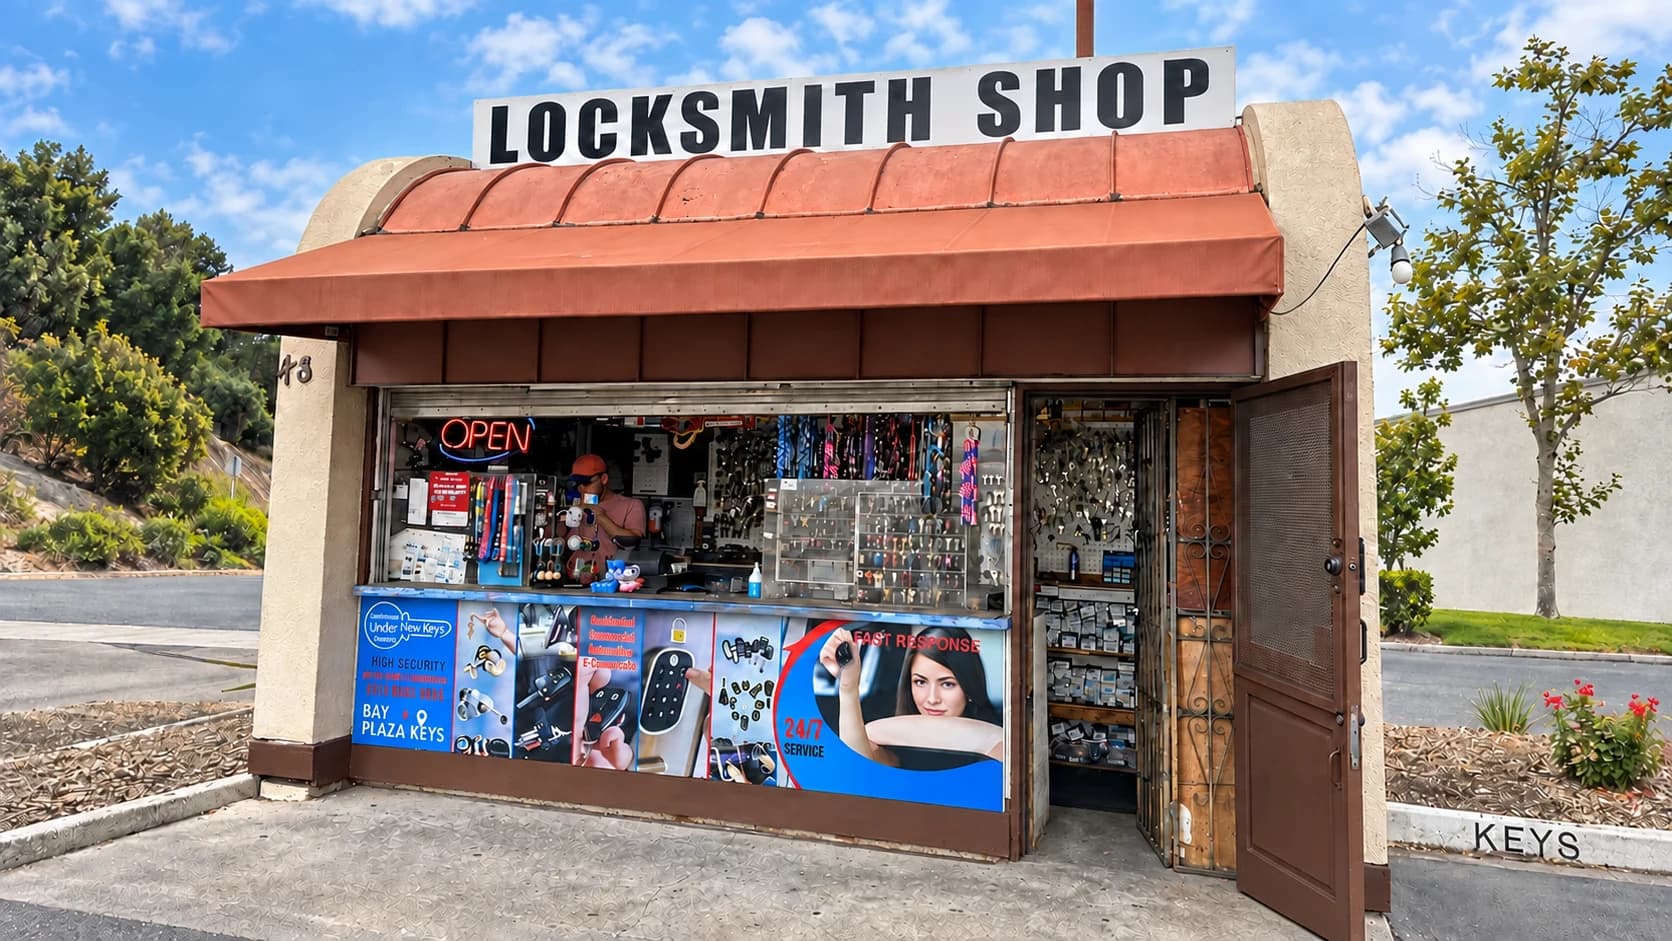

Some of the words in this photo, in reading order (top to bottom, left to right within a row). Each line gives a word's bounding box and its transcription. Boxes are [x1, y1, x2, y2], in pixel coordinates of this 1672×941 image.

[489, 77, 931, 165] LOCKSMITH
[977, 58, 1209, 138] SHOP
[276, 354, 312, 386] 48
[441, 418, 530, 453] OPEN
[369, 621, 398, 633] Under
[400, 621, 421, 633] New
[423, 622, 446, 638] Keys
[852, 630, 892, 647] FAST
[896, 634, 981, 654] RESPONSE
[371, 655, 394, 668] HIGH
[398, 657, 447, 672] SECURITY
[362, 703, 390, 719] BAY
[361, 720, 405, 739] PLAZA
[410, 724, 445, 742] KEYS
[784, 717, 823, 741] 24/7
[784, 742, 825, 758] SERVICE
[1474, 822, 1580, 861] KEYS
